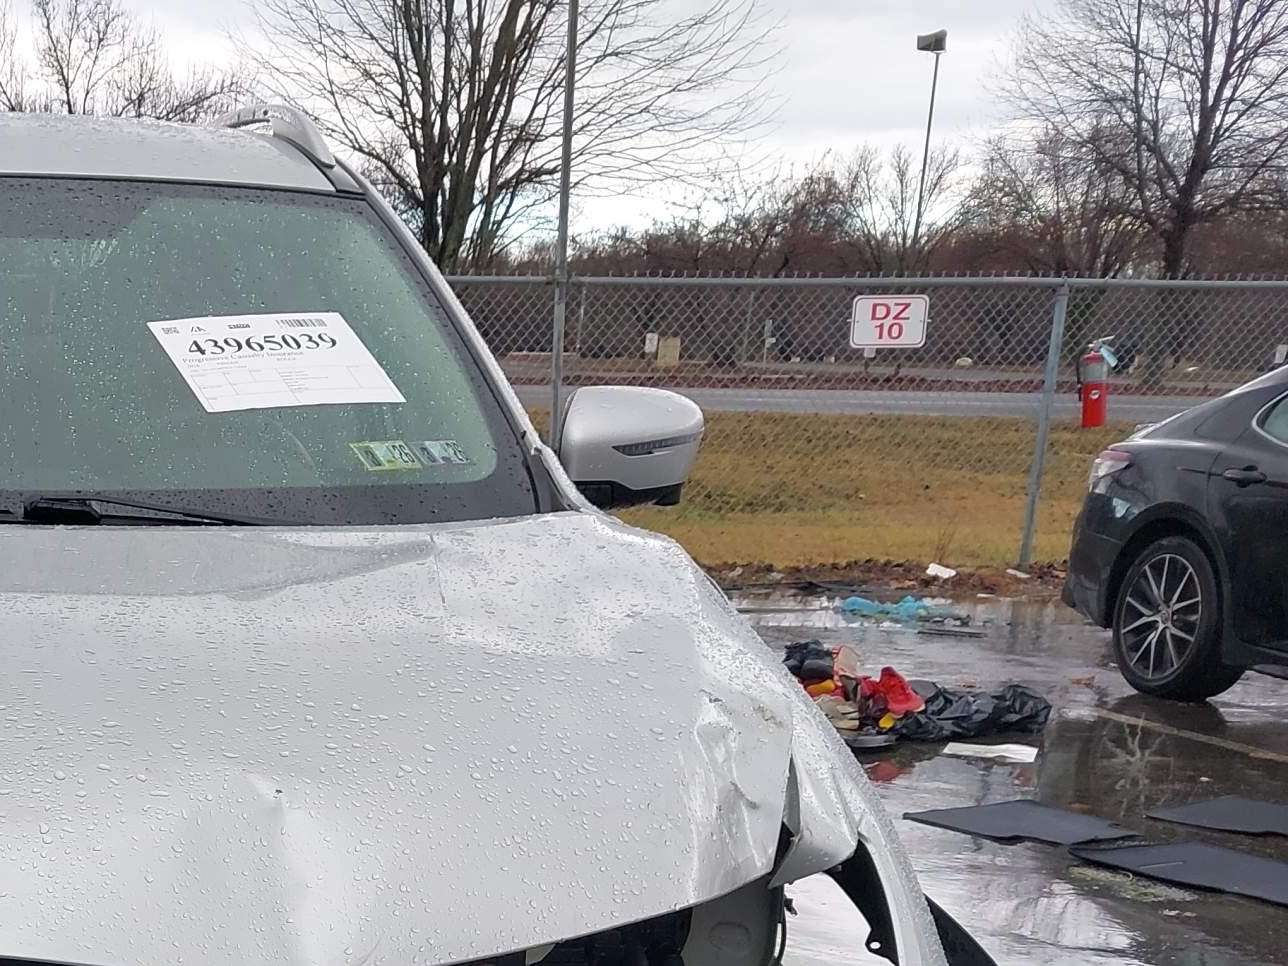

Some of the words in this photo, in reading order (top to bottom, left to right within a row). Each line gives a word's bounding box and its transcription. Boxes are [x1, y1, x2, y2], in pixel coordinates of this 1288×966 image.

[871, 302, 912, 320] DZ
[874, 322, 904, 340] 10
[188, 332, 337, 356] 43965039
